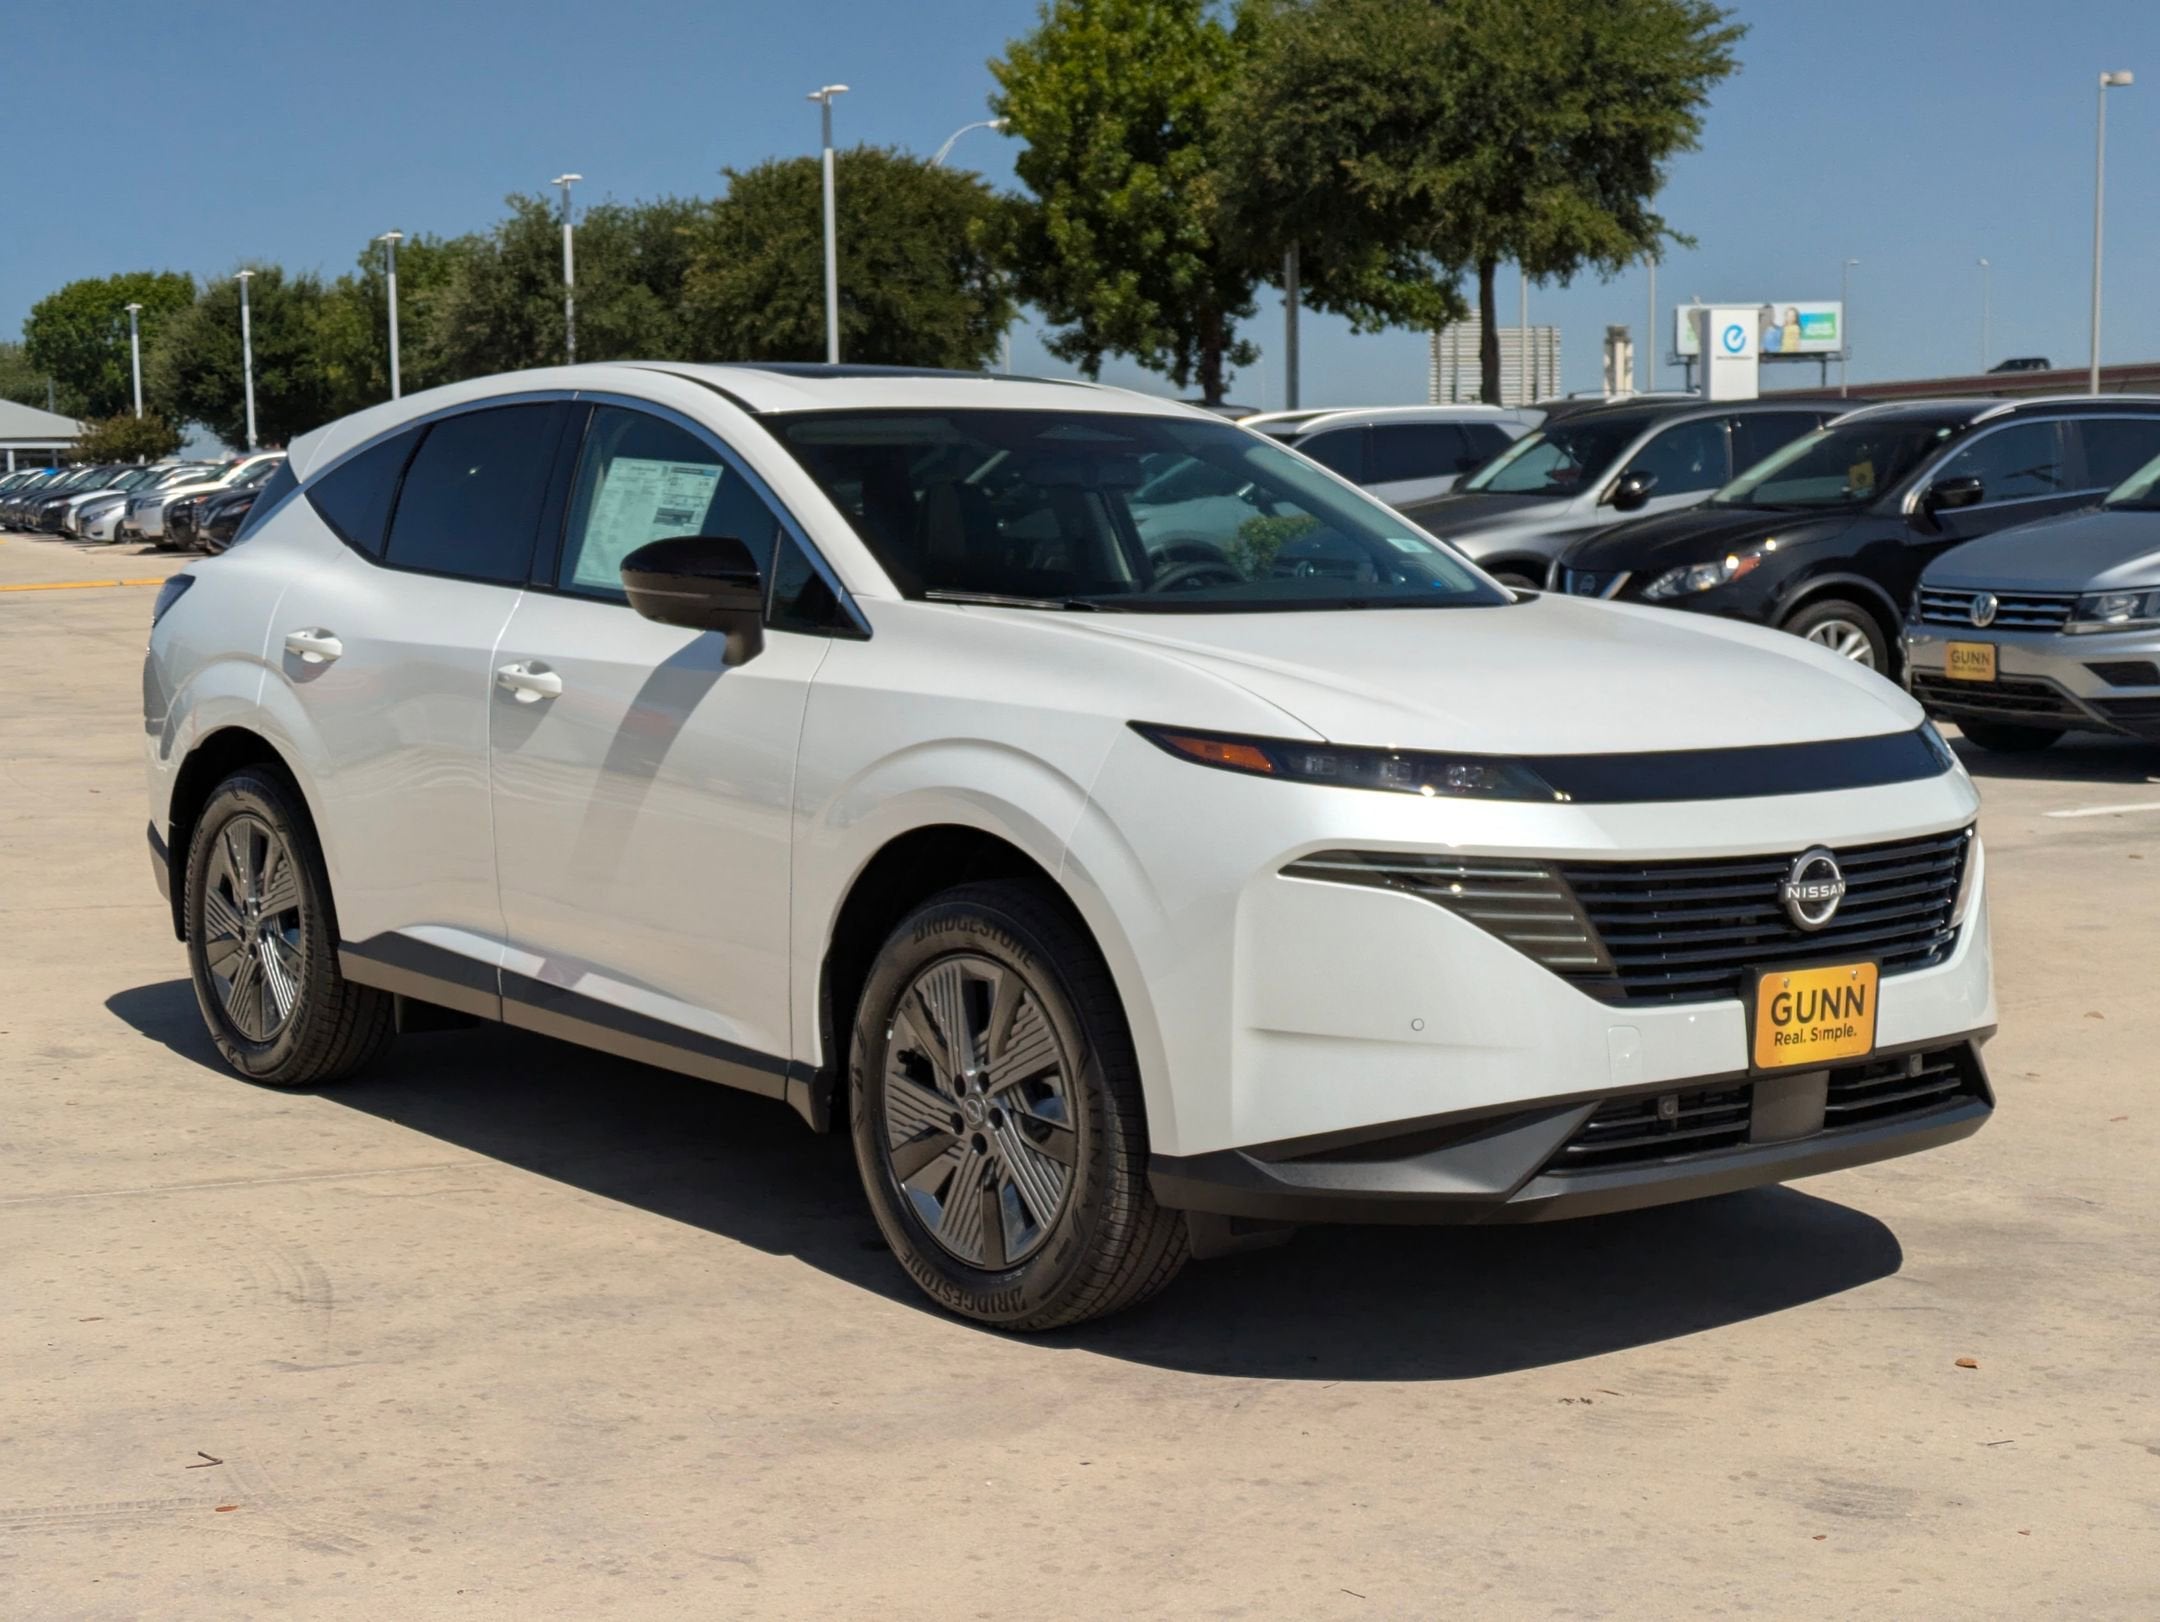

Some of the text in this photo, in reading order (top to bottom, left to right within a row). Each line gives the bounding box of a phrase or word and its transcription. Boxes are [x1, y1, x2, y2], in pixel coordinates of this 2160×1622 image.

[1951, 649, 1991, 666] GUNN
[1787, 881, 1846, 899] NISSAN
[911, 914, 1038, 970] BRIDGESTONE
[1771, 984, 1865, 1027] GUNN
[1774, 1028, 1806, 1046] Real.
[900, 1248, 1028, 1314] BRIDGESTONE
